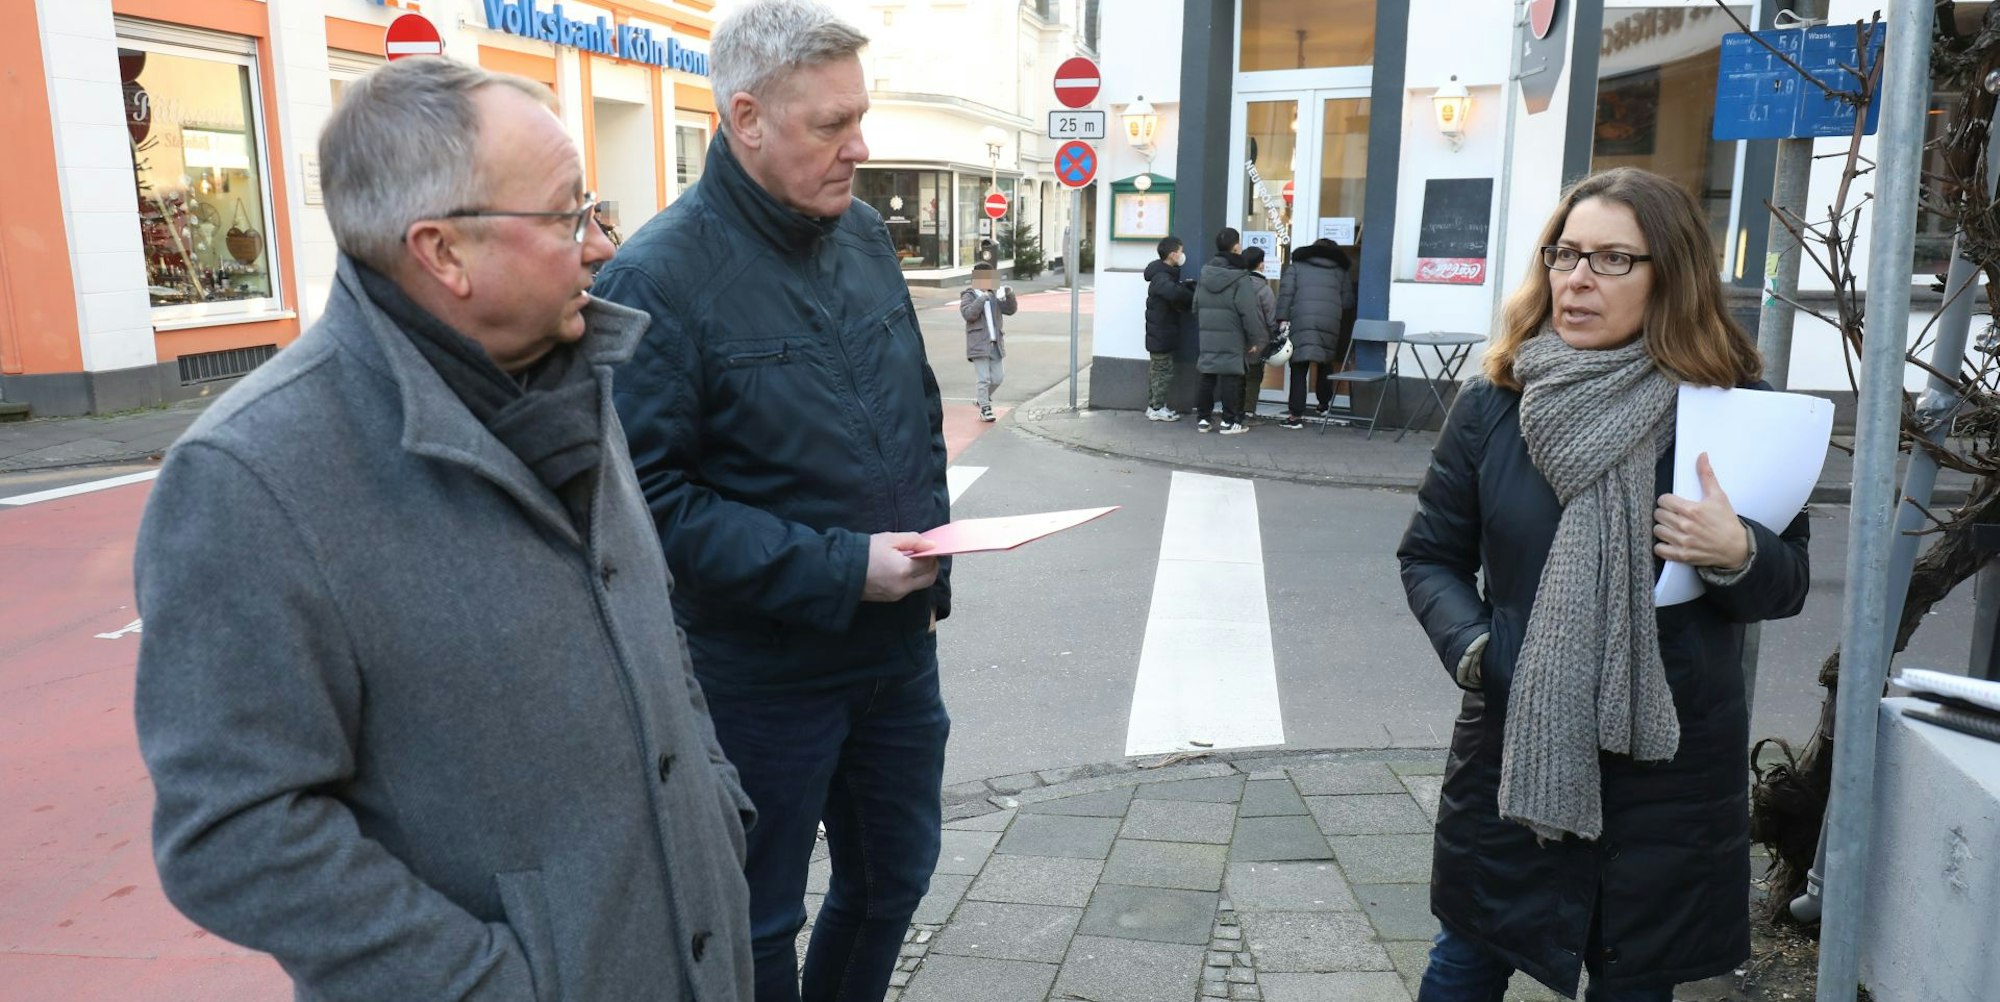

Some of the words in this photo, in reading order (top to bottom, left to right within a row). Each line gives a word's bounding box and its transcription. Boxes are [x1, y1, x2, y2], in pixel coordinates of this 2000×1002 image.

[483, 0, 616, 54] Volksbank
[618, 24, 666, 67] Köln
[1749, 105, 1769, 121] 6.1
[1059, 118, 1077, 132] 25
[1084, 121, 1095, 132] m
